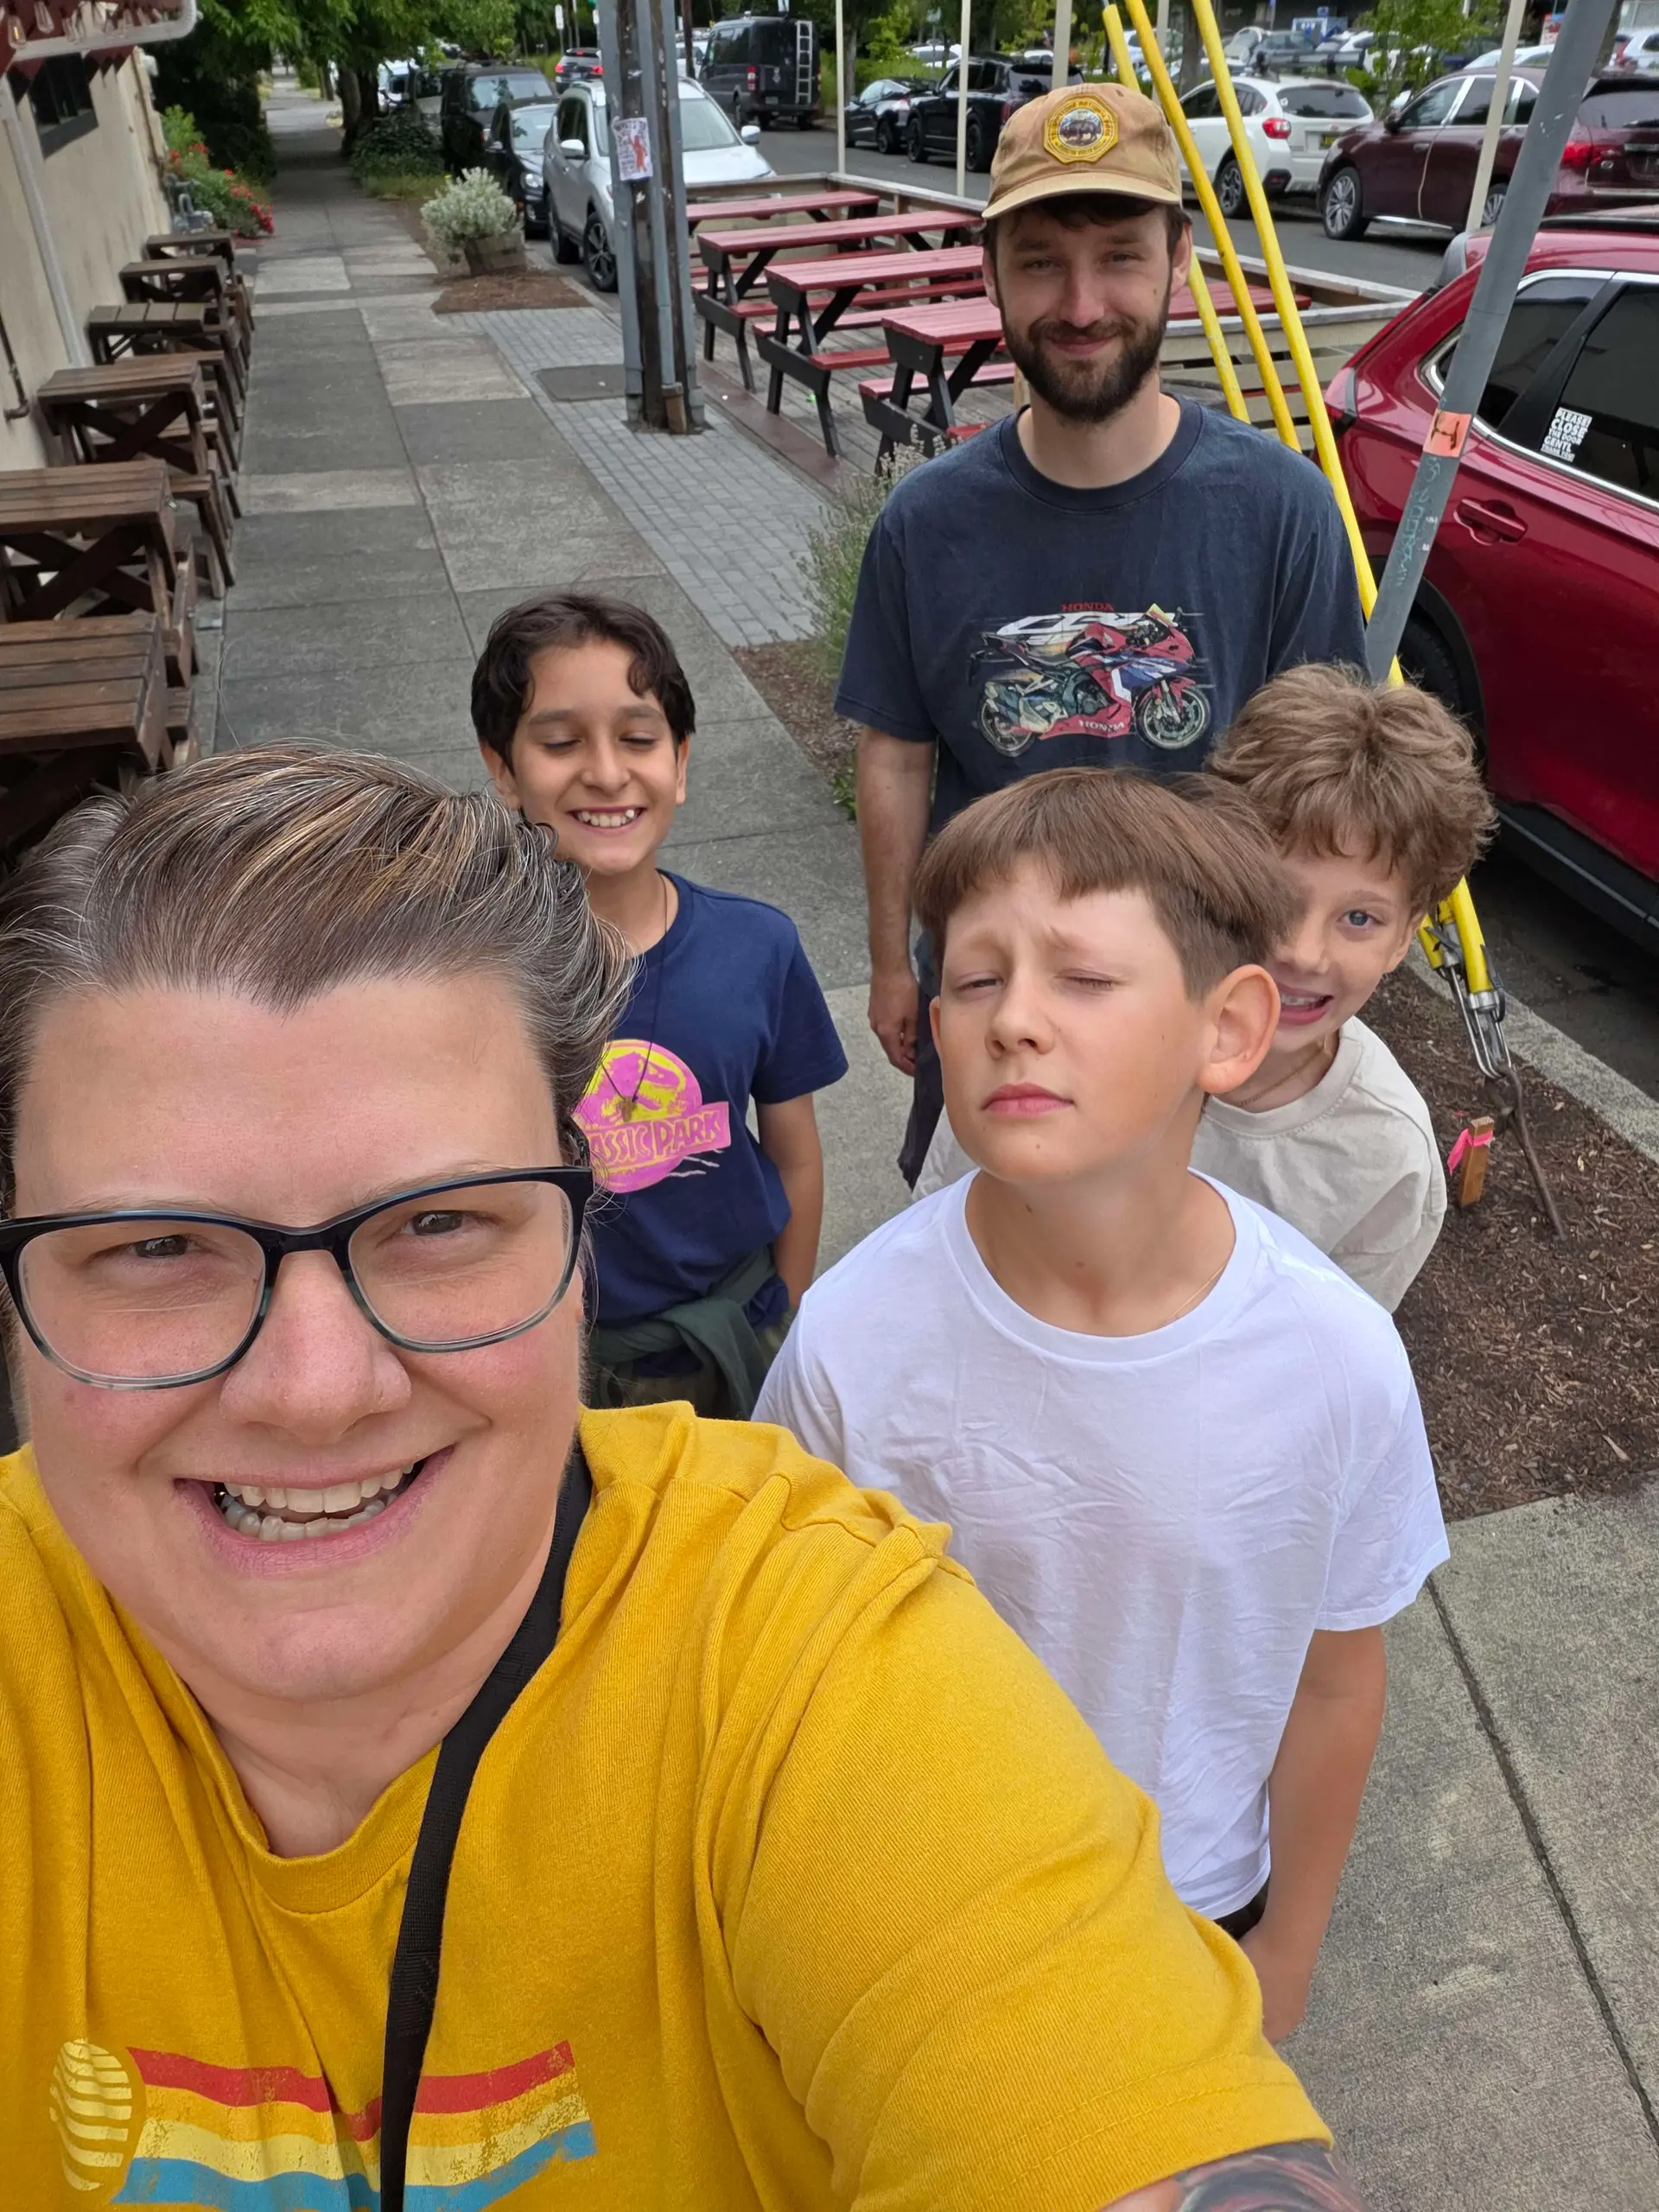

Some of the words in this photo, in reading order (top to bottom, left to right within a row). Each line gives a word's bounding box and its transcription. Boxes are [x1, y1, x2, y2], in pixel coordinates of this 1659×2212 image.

[1551, 418, 1588, 437] CLOSE
[1548, 428, 1562, 439] THE
[1561, 433, 1583, 446] DOOR
[1061, 601, 1115, 613] HONDA
[589, 1124, 654, 1167] ASSIC
[652, 1109, 723, 1159] PARK
